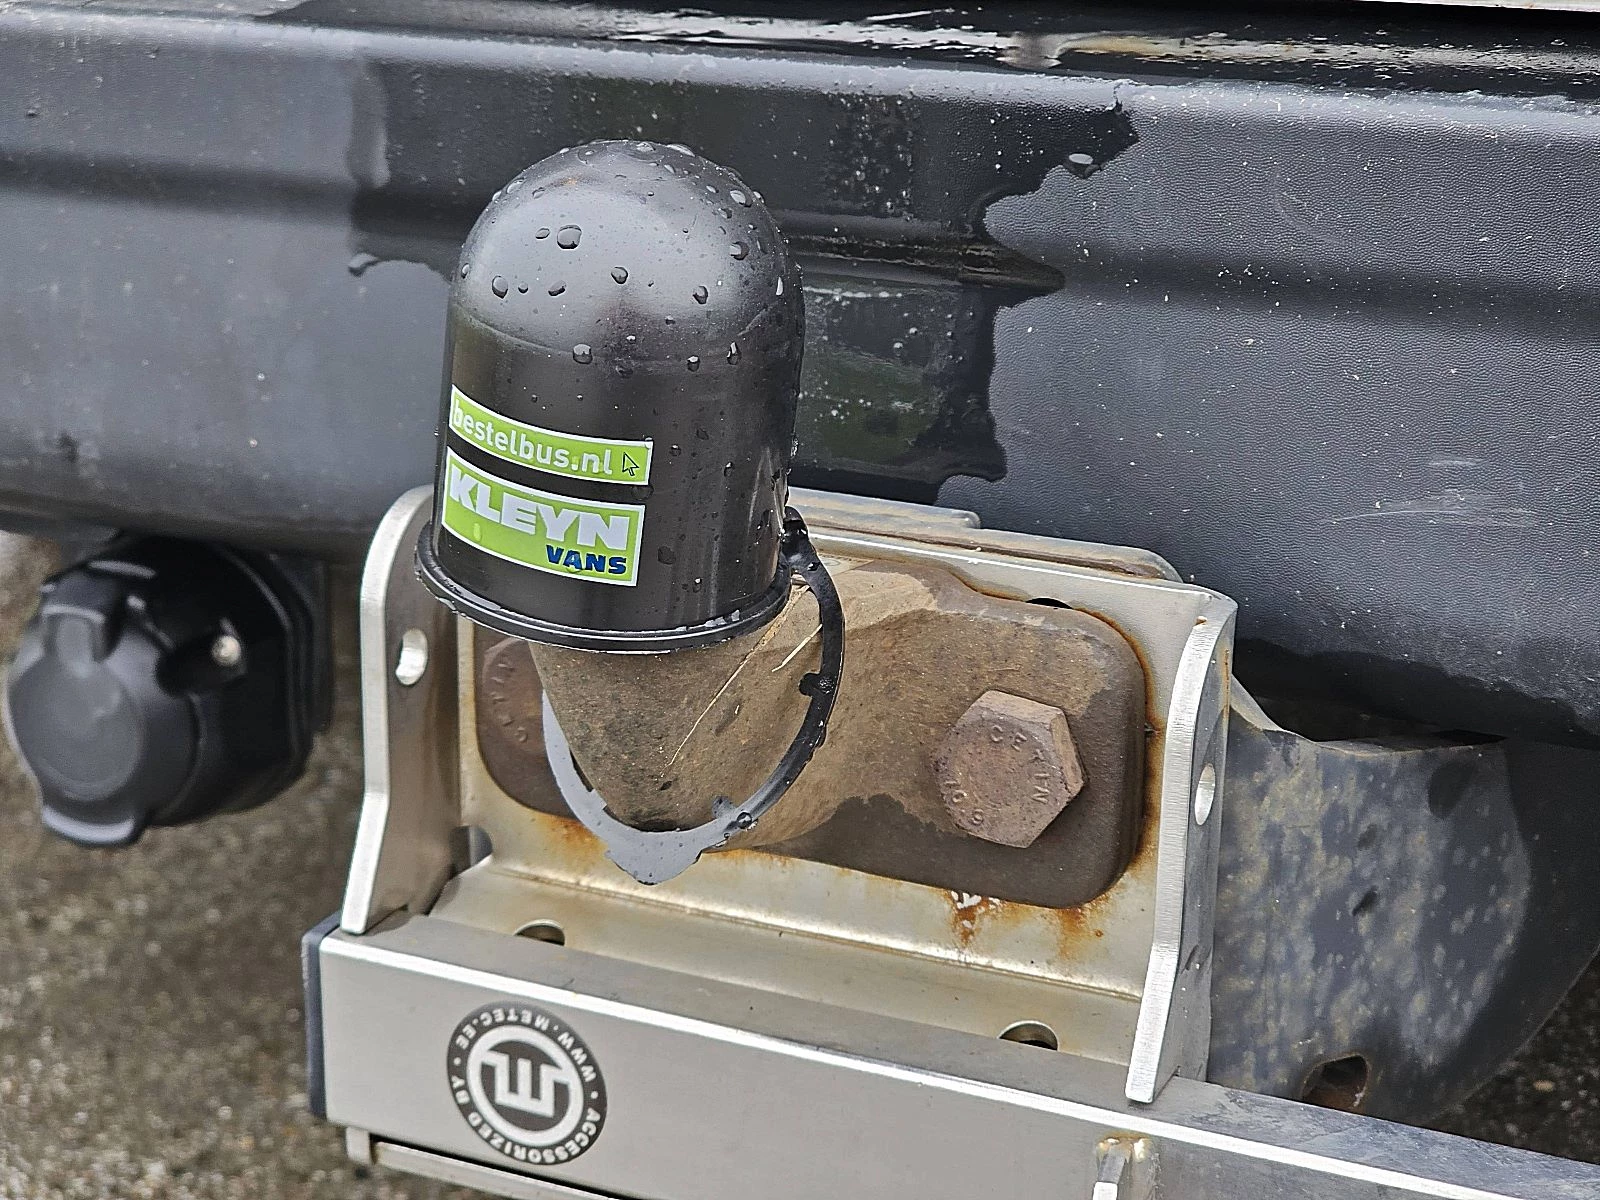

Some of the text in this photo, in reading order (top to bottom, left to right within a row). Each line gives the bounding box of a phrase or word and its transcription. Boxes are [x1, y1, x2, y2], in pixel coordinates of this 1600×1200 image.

[452, 399, 613, 475] bestelbus.nl
[450, 463, 630, 550] KLEYN
[546, 544, 627, 575] VANS
[450, 1075, 601, 1164] ACCESSORIZED BY
